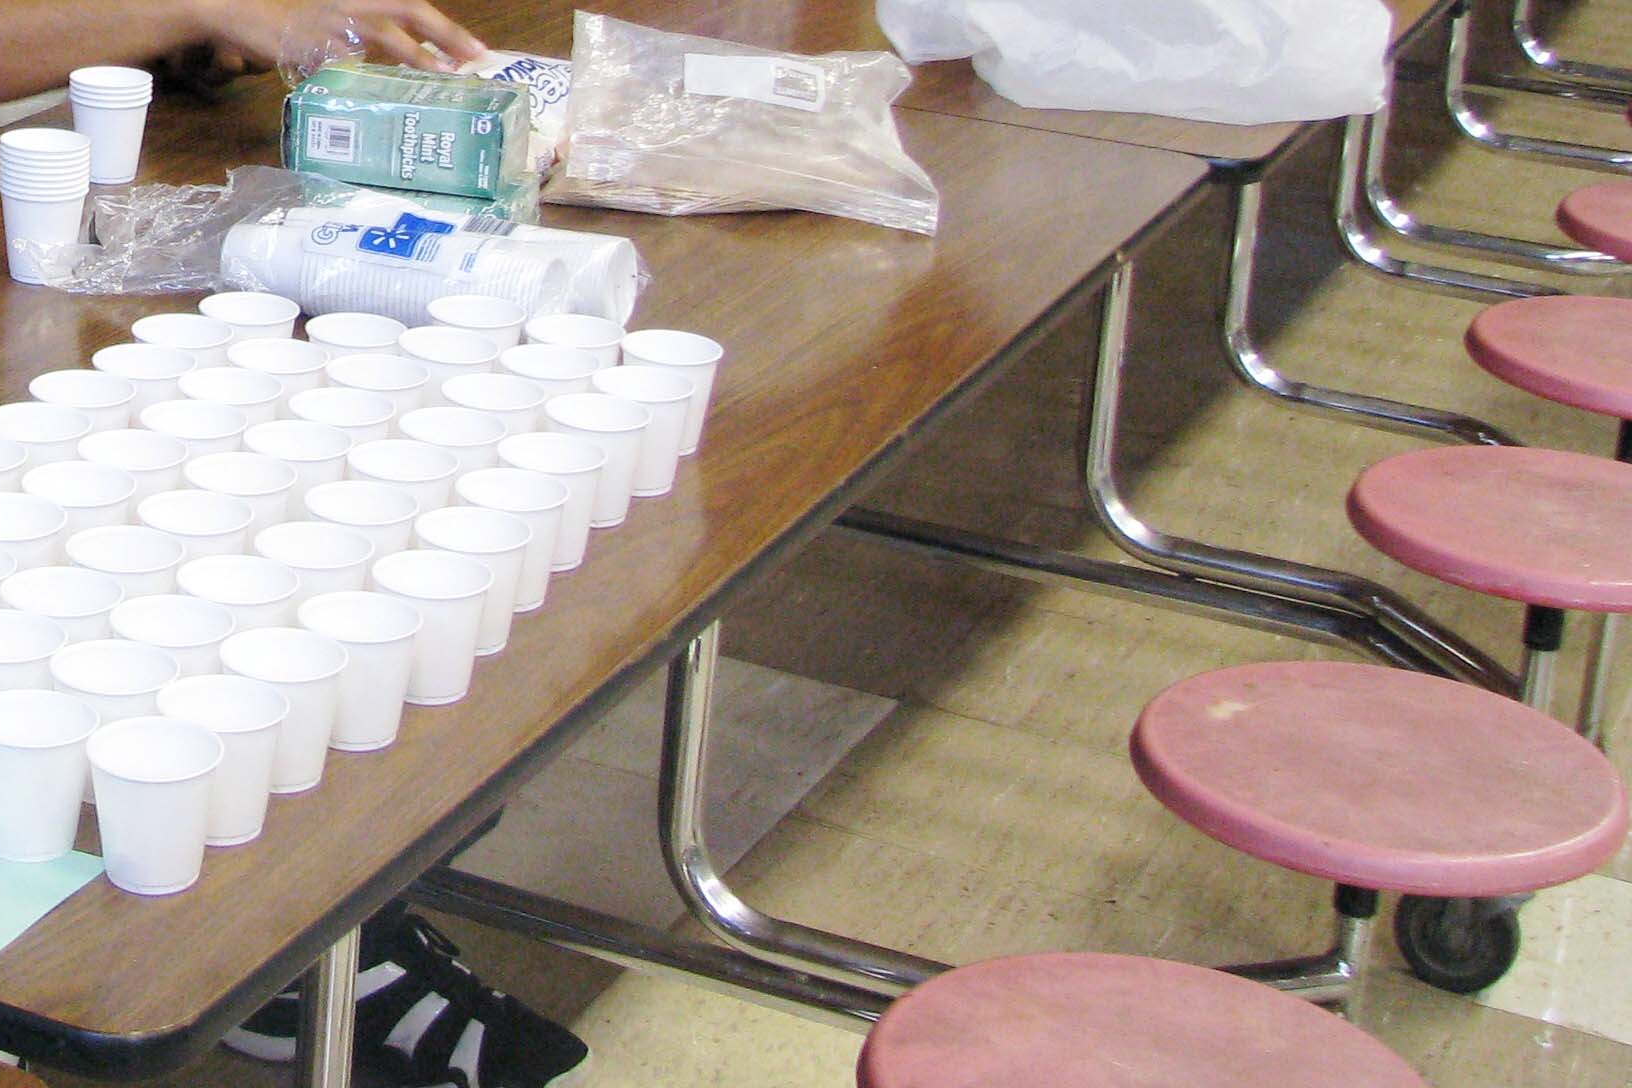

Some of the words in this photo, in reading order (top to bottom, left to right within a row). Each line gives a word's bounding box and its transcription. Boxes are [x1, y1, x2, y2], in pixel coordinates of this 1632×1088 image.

[399, 111, 420, 181] Toothpicks
[420, 133, 436, 163] Mint
[436, 131, 456, 169] Royal
